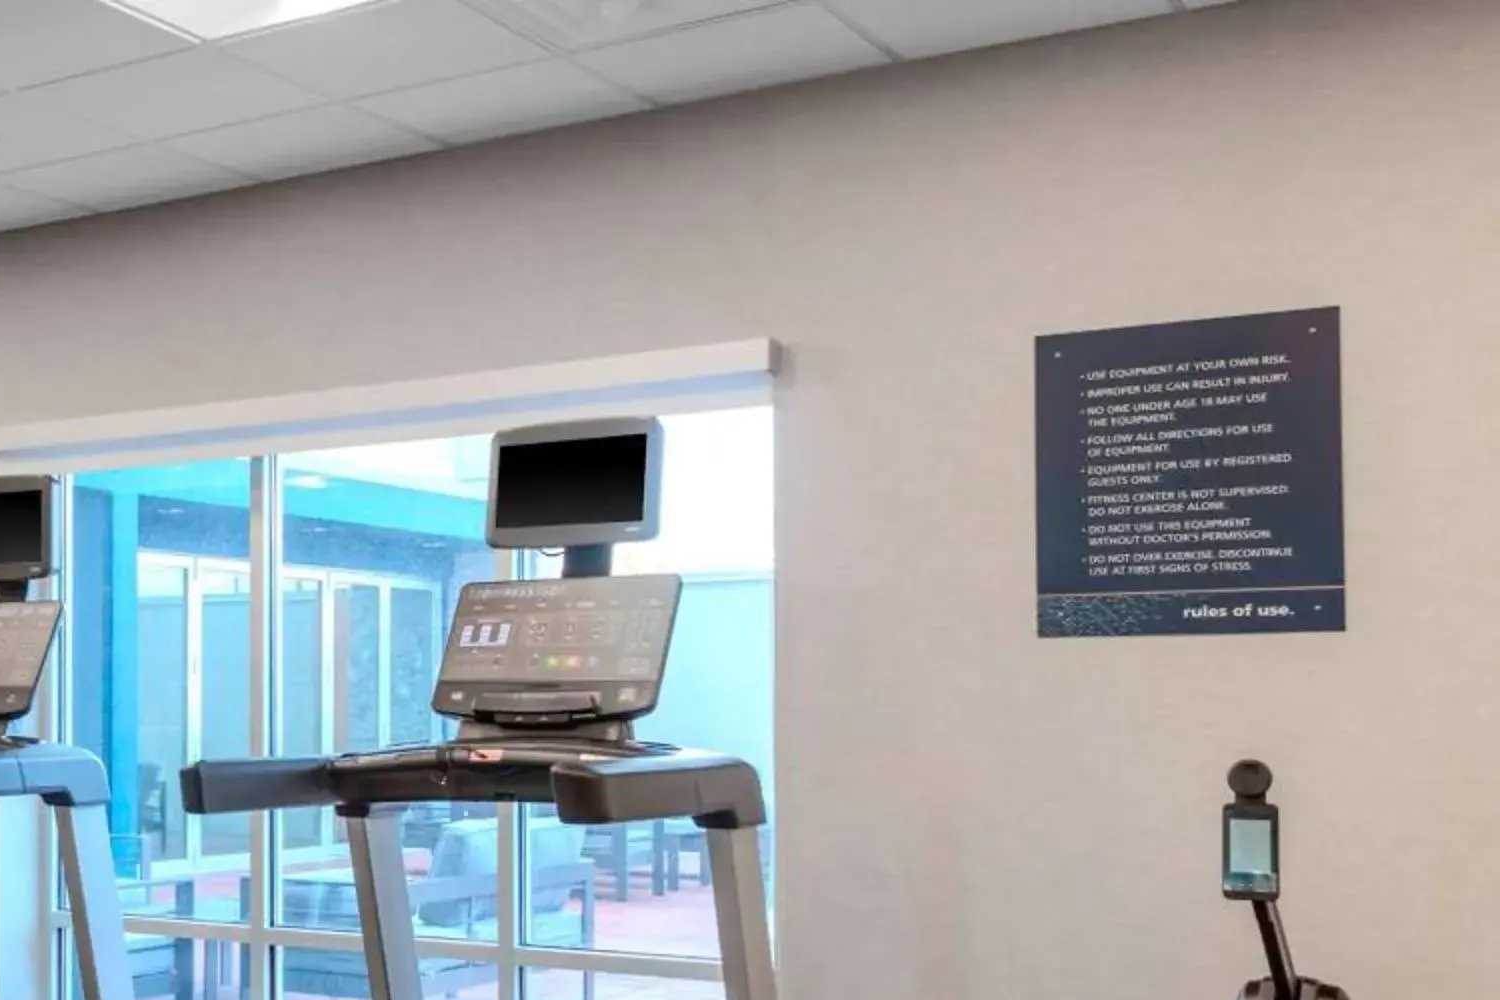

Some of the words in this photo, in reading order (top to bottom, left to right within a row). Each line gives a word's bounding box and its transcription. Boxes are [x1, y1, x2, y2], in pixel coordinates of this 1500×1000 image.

[1086, 370, 1106, 380] USE
[1108, 364, 1173, 378] EQUIPMENT
[1175, 362, 1190, 372] AT
[1193, 359, 1226, 371] YOUR
[1228, 356, 1260, 368] OWN
[1086, 384, 1141, 397] IMPROPER
[1143, 382, 1163, 393] USE
[1165, 380, 1190, 391] CAN
[1191, 377, 1231, 389] RESULT
[1233, 375, 1247, 385] IN
[1085, 405, 1105, 415] NO
[1106, 403, 1130, 414] ONE
[1131, 400, 1171, 412] UNDER
[1172, 398, 1197, 409] AGE
[1200, 396, 1214, 406] 18
[1214, 394, 1243, 405] MAY
[1245, 392, 1267, 403] USE
[1087, 417, 1108, 427] THE
[1086, 433, 1134, 445] FOLLOW
[1134, 431, 1156, 441] ALL
[1157, 426, 1223, 440] DIRECTIONS
[1225, 424, 1249, 435] FOR
[1251, 423, 1273, 433] USE
[1086, 447, 1103, 457] OF
[1086, 462, 1152, 475] EQUIPMENT
[1154, 460, 1178, 470] FOR
[1179, 458, 1201, 469] USE
[1203, 457, 1220, 467] BY
[1222, 452, 1292, 466] REGISTERED
[1086, 475, 1129, 487] GUESTS
[1087, 493, 1130, 504] FITNESS
[1131, 490, 1175, 502] CENTER
[1176, 490, 1188, 499] IS
[1189, 488, 1215, 498] NOT
[1087, 507, 1106, 516] DO
[1106, 505, 1132, 515] NOT
[1133, 502, 1185, 514] EXERCISE
[1087, 524, 1106, 534] DO
[1107, 523, 1131, 533] NOT
[1132, 522, 1155, 532] USE
[1157, 521, 1182, 531] THIS
[1183, 517, 1252, 529] EQUIPMENT
[1087, 535, 1142, 546] WITHOUT
[1088, 554, 1106, 564] DO
[1107, 553, 1131, 563] NOT
[1132, 552, 1162, 562] OVER
[1217, 546, 1293, 558] DISCONTINUE
[1088, 566, 1108, 576] USE
[1110, 565, 1126, 575] AT
[1127, 564, 1156, 574] FIRST
[1158, 563, 1191, 573] SIGNS
[1192, 562, 1209, 572] OF
[1182, 603, 1229, 618] rules
[1231, 603, 1253, 617] of
[1256, 604, 1295, 616] use.
